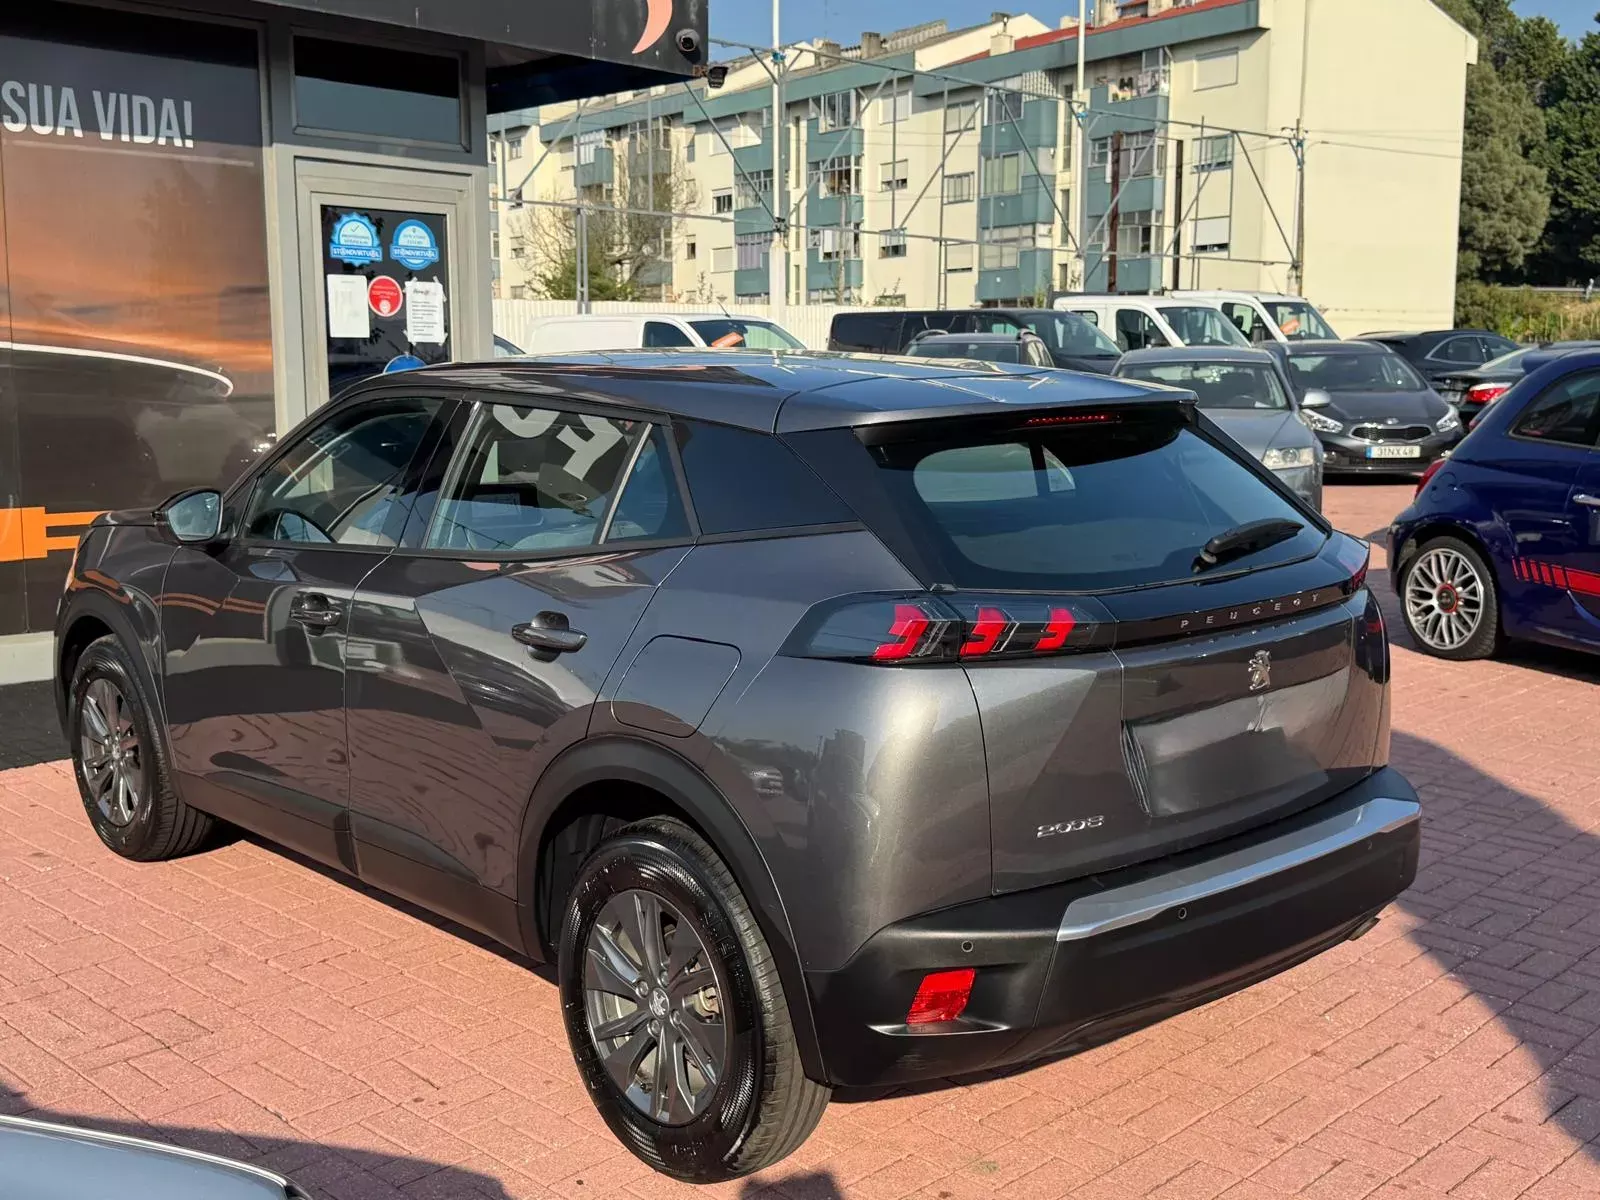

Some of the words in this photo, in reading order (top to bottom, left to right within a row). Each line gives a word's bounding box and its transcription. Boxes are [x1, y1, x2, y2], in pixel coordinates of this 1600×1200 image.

[1, 80, 84, 138] SUA
[92, 90, 194, 149] VIDA!
[1180, 592, 1319, 629] PEUGEOT
[1036, 814, 1105, 839] 2008
